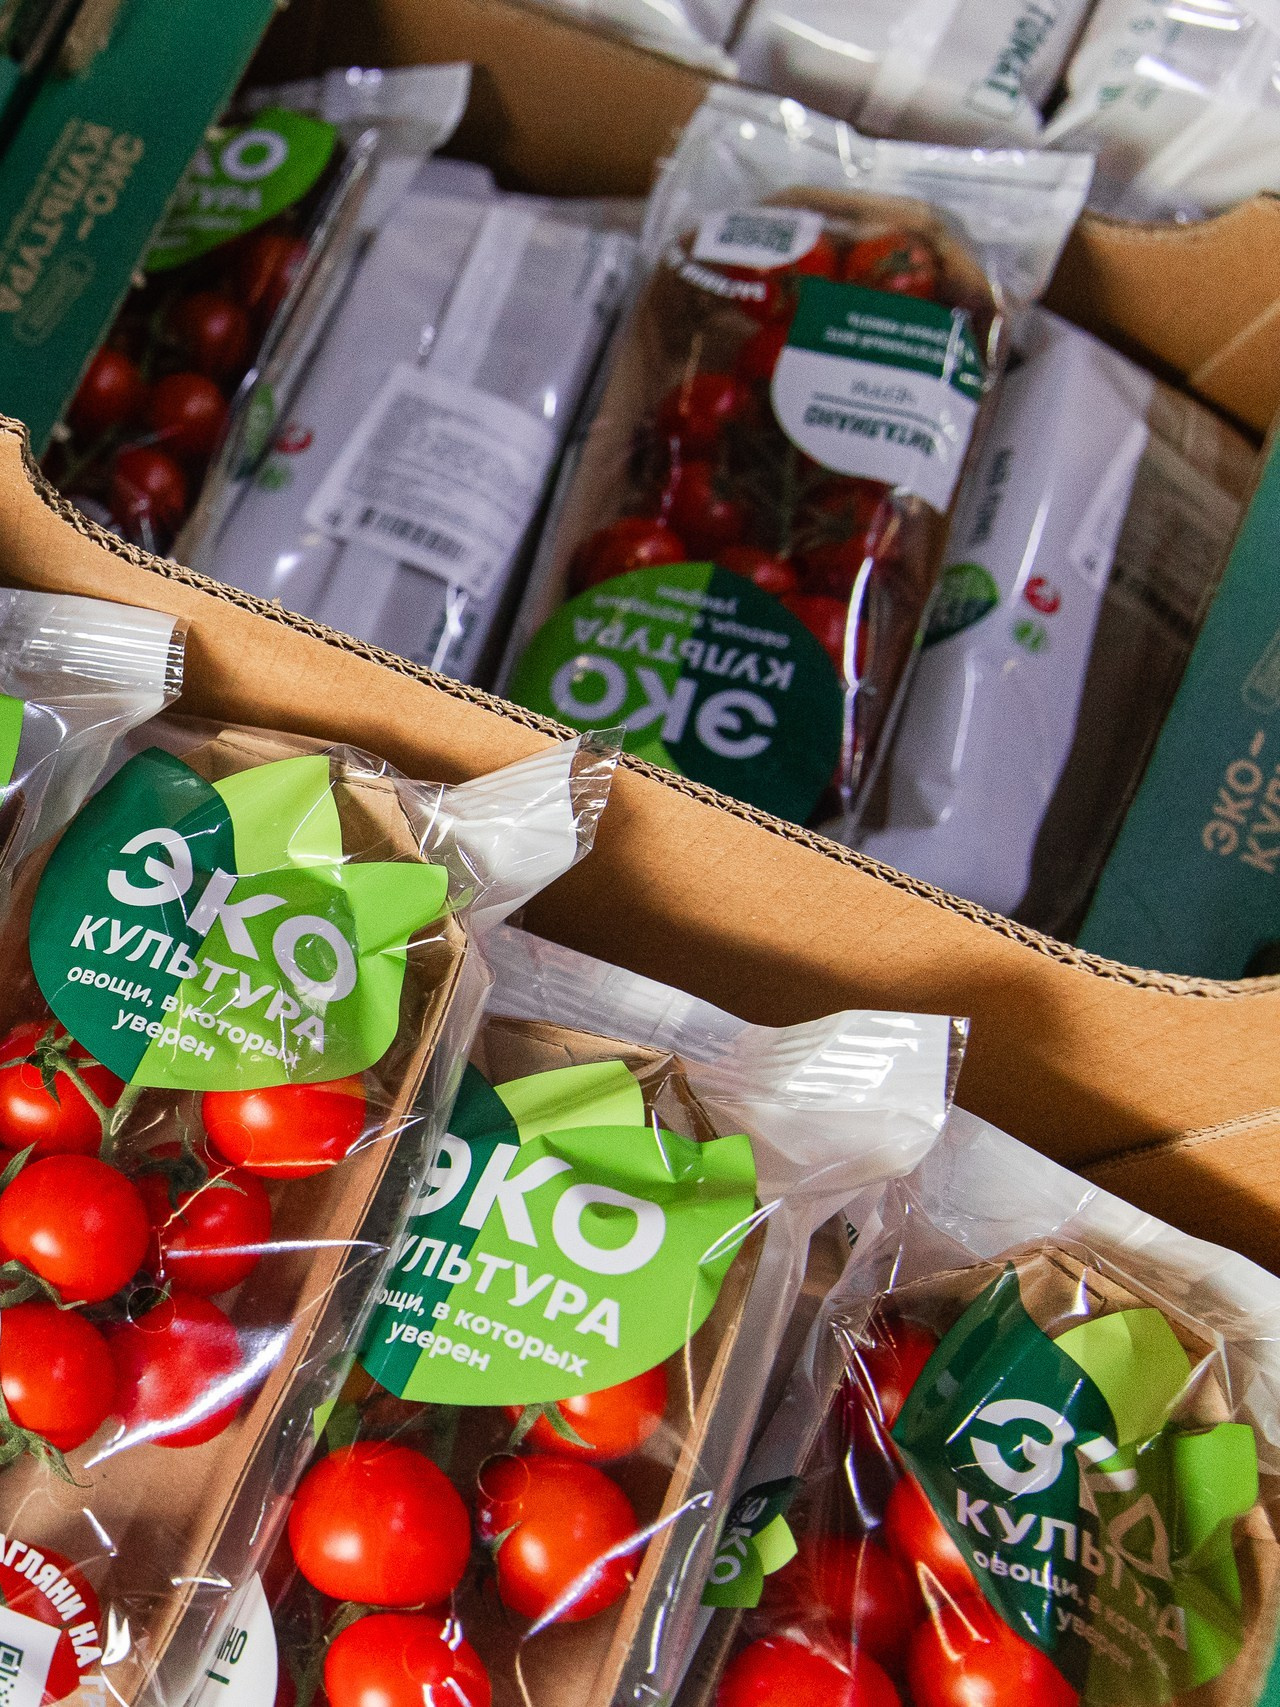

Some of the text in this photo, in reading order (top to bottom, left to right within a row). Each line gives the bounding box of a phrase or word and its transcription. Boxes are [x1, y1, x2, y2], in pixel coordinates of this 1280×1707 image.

[573, 616, 796, 691] КУЛЬТУРА
[550, 654, 778, 760] ЭКО
[107, 828, 358, 1002] ЭКО
[66, 966, 302, 1070] овощи, в которых
[70, 915, 325, 1055] КУЛЬТУРА
[111, 1009, 216, 1062] уверен
[410, 1132, 667, 1276] ЭКО
[396, 1234, 621, 1349] УЛЬТУРА
[431, 1301, 450, 1320] в
[453, 1308, 590, 1378] которых
[385, 1321, 491, 1372] уверен
[710, 1497, 768, 1585] ЭКО
[69, 1620, 103, 1668] НА
